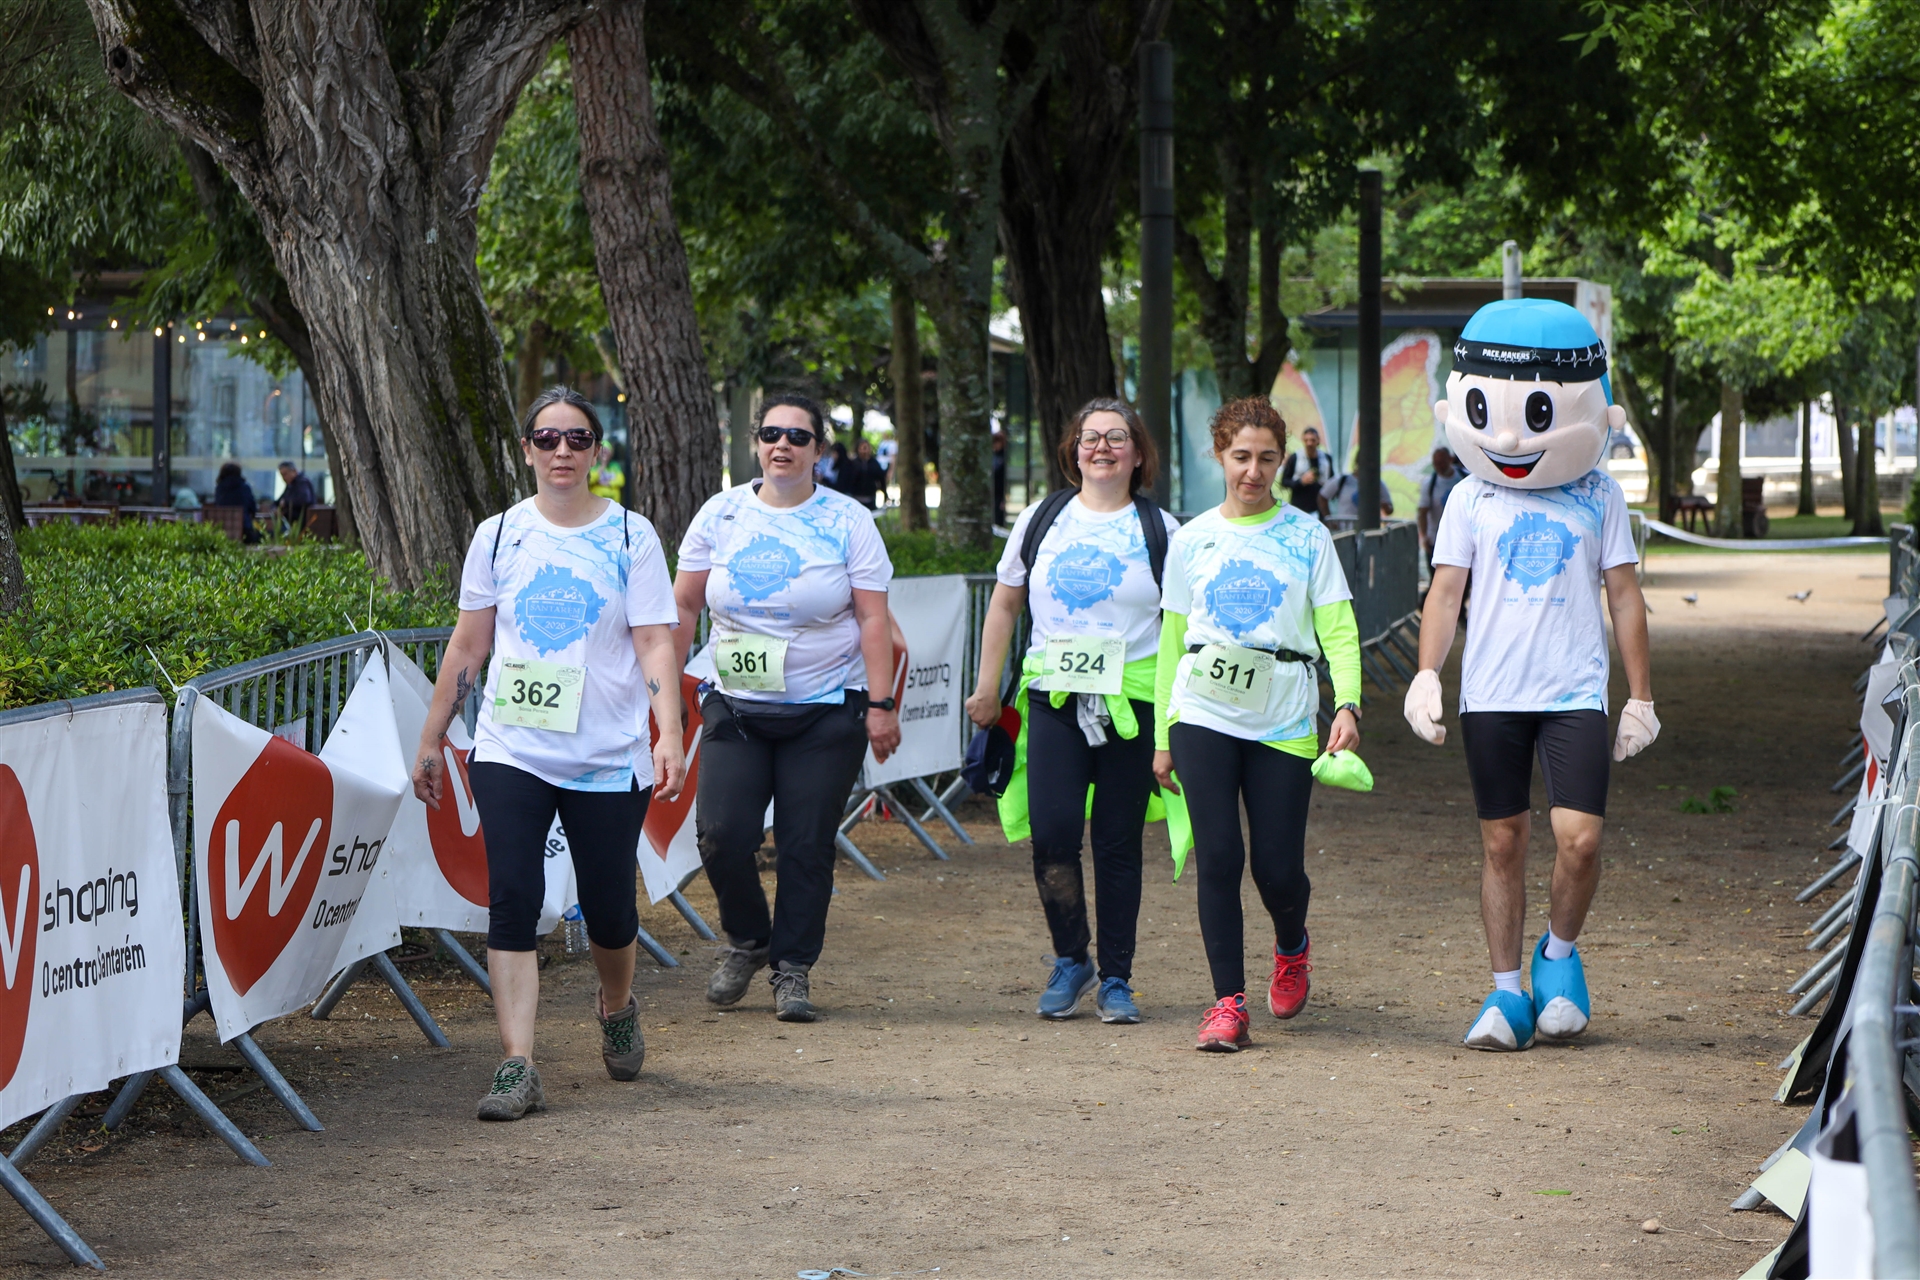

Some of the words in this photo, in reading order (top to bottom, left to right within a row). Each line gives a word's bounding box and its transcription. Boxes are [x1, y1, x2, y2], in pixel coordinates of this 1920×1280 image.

[1482, 348, 1500, 358] PACE
[1500, 349, 1530, 360] MAKERS
[545, 620, 566, 630] 2026
[731, 651, 767, 673] 361
[1059, 651, 1105, 675] 524
[1209, 657, 1256, 690] 511
[511, 678, 561, 708] 362
[225, 817, 323, 921] W
[313, 899, 327, 930] O
[42, 960, 50, 998] O
[51, 957, 98, 995] centro
